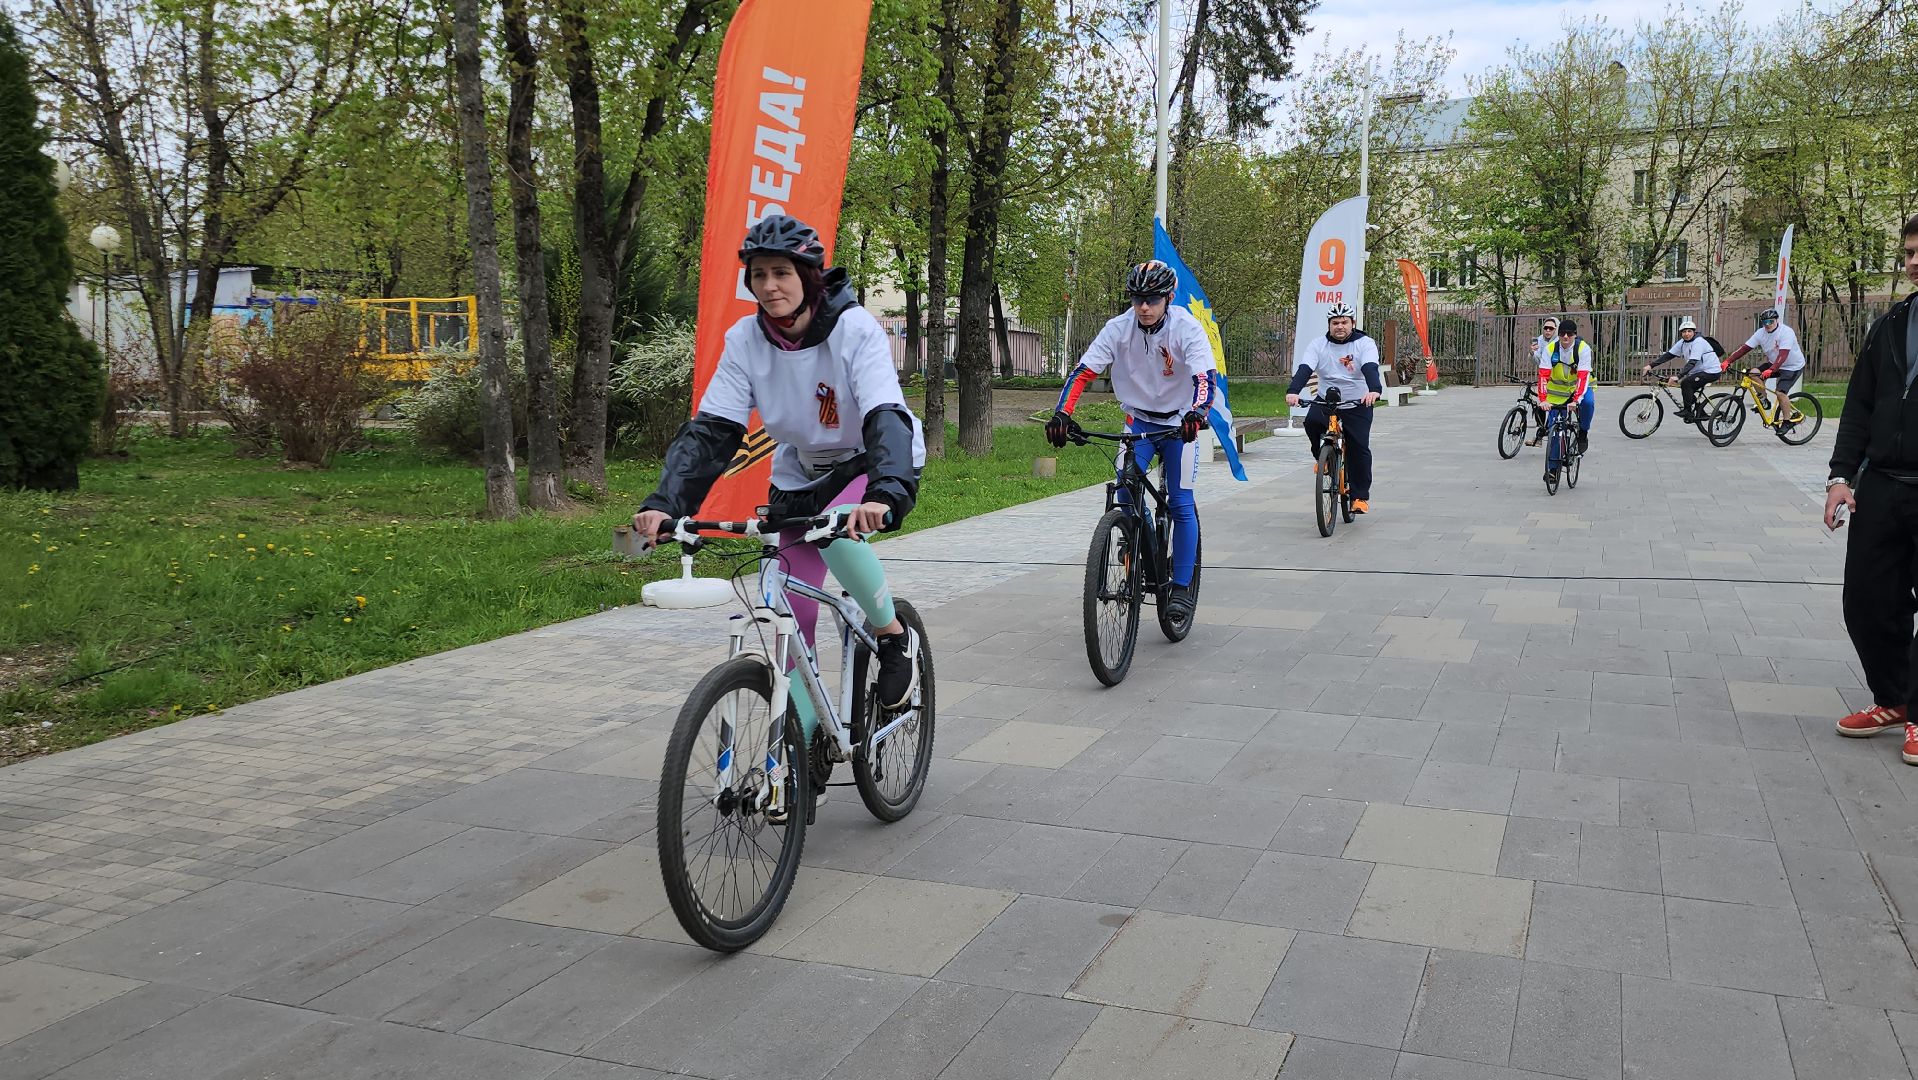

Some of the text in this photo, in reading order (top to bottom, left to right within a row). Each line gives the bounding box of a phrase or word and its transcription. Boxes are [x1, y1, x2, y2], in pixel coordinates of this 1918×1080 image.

[735, 66, 806, 302] БЕДА!
[1319, 239, 1346, 286] 9
[1315, 291, 1342, 303] МАЯ
